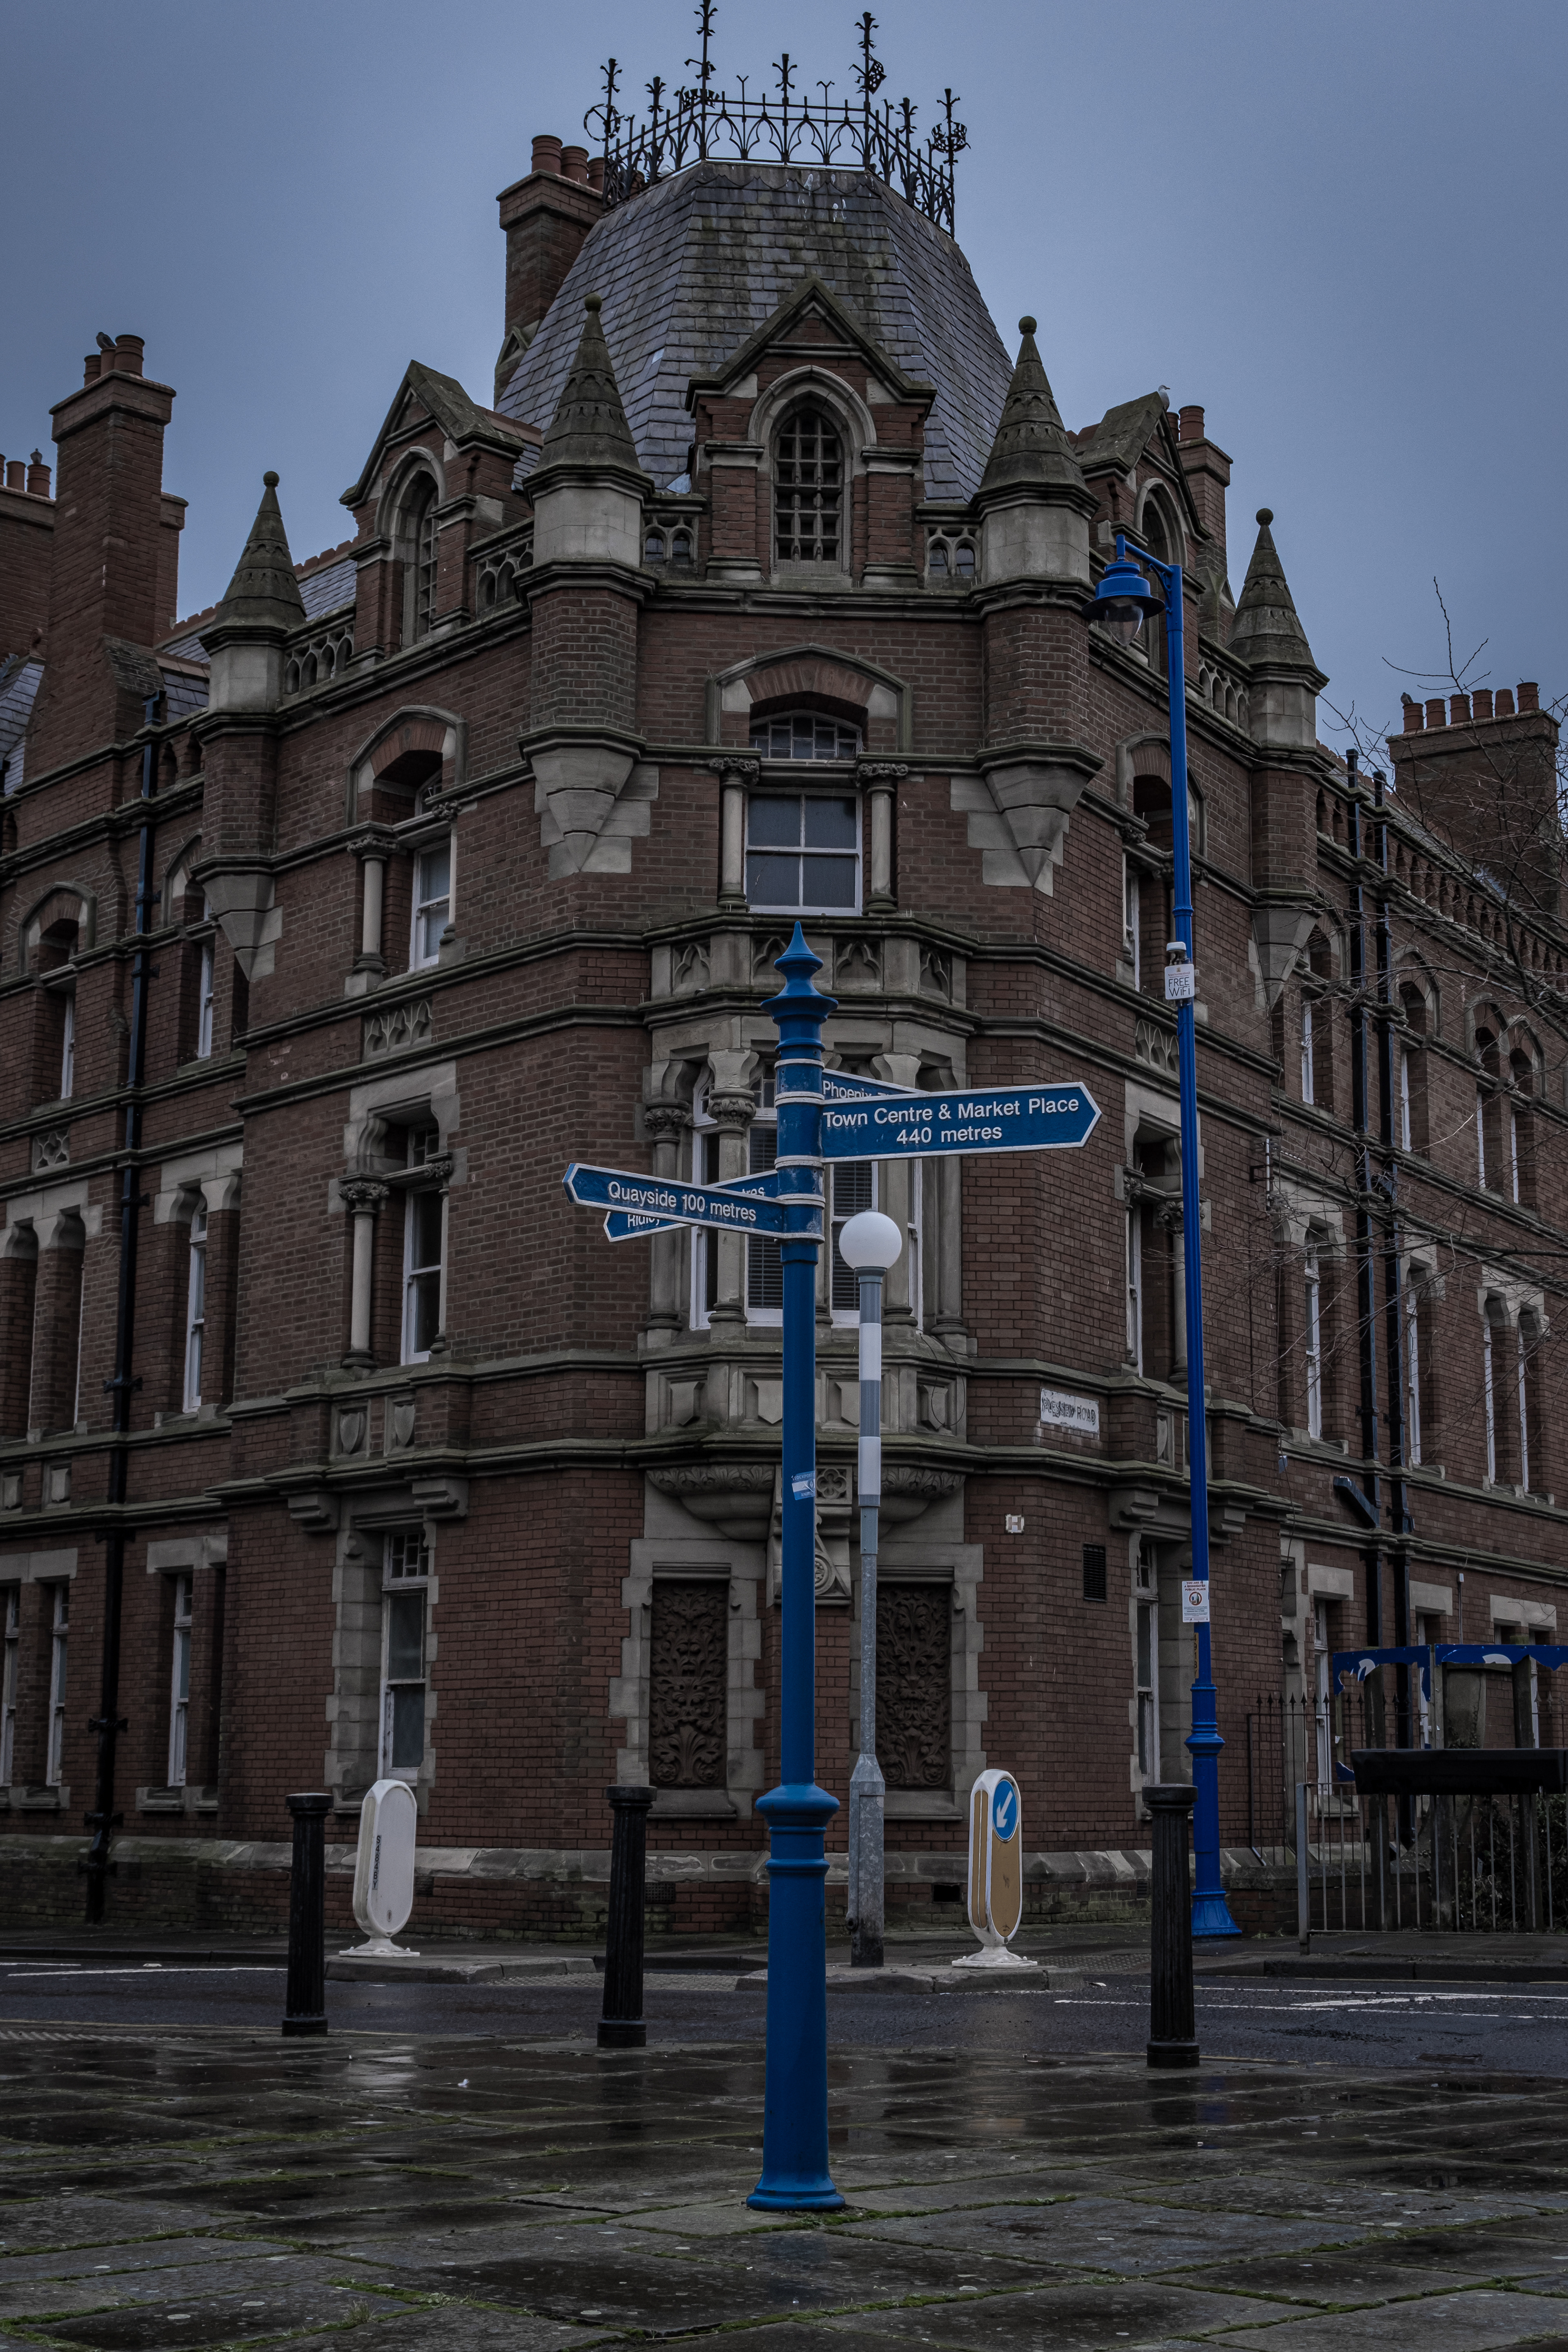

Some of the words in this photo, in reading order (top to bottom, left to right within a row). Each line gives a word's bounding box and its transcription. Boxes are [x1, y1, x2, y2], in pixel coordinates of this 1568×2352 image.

[1169, 977, 1189, 987] FREE
[823, 1111, 868, 1127] Town
[874, 1107, 933, 1124] Centre
[939, 1104, 952, 1120] &
[958, 1101, 1020, 1119] Market
[1029, 1098, 1079, 1114] Place
[896, 1127, 932, 1144] 440
[941, 1126, 1002, 1143] metres
[608, 1181, 677, 1207] Quayside
[682, 1194, 705, 1212] 100
[710, 1203, 756, 1221] metres
[1077, 1405, 1096, 1423] ROAD
